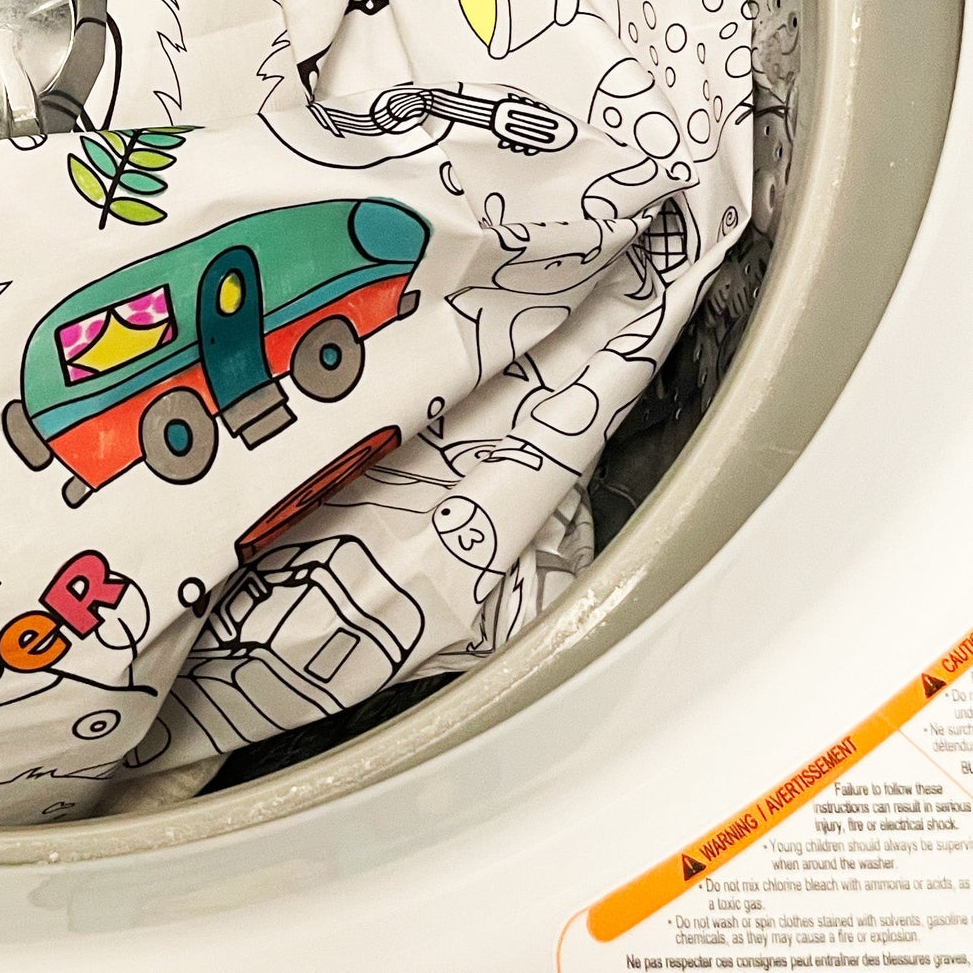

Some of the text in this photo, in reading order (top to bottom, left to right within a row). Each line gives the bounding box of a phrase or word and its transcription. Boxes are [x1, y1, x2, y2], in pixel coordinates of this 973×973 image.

[834, 782, 943, 796] Failure to follow these
[698, 813, 759, 862] WARNING
[764, 735, 858, 815] AVERTISSEMENT
[872, 802, 891, 813] can
[893, 800, 921, 813] result
[923, 800, 933, 813] in
[935, 800, 972, 813] serious
[848, 817, 864, 831] fire
[866, 820, 877, 831] or
[880, 817, 924, 830] electrical
[769, 839, 803, 855] Young
[806, 839, 844, 852] children
[848, 839, 880, 852] should
[884, 838, 918, 854] always
[920, 837, 933, 851] be
[771, 857, 799, 870] when
[802, 857, 837, 870] around
[840, 857, 856, 870] the
[705, 878, 721, 893] Do
[724, 878, 740, 892] not
[742, 878, 760, 891] mix
[763, 877, 802, 891] chlorine
[805, 878, 838, 891] bleach
[841, 877, 861, 890] with
[865, 877, 910, 890] ammonia
[913, 879, 923, 890] or
[959, 879, 970, 889] as
[708, 898, 766, 913] a toxic gas.
[675, 914, 691, 928] Do
[694, 914, 710, 928] not
[713, 914, 738, 928] wash
[742, 916, 752, 928] or
[755, 914, 776, 932] spin
[779, 914, 814, 928] clothes
[817, 914, 853, 928] stained
[857, 914, 877, 927] with
[927, 913, 968, 930] gasoline
[732, 934, 744, 944] as
[747, 931, 769, 947] they
[771, 933, 792, 947] may
[796, 932, 826, 944] cause
[829, 933, 836, 943] a
[838, 929, 854, 943] fire
[857, 932, 867, 943] or
[626, 955, 641, 969] Ne
[644, 957, 663, 972] pas
[665, 955, 713, 971] respecter
[716, 957, 734, 969] ces
[736, 954, 788, 971] consignes
[790, 954, 813, 971] peut
[862, 953, 880, 967] des
[882, 953, 931, 967] blessures
